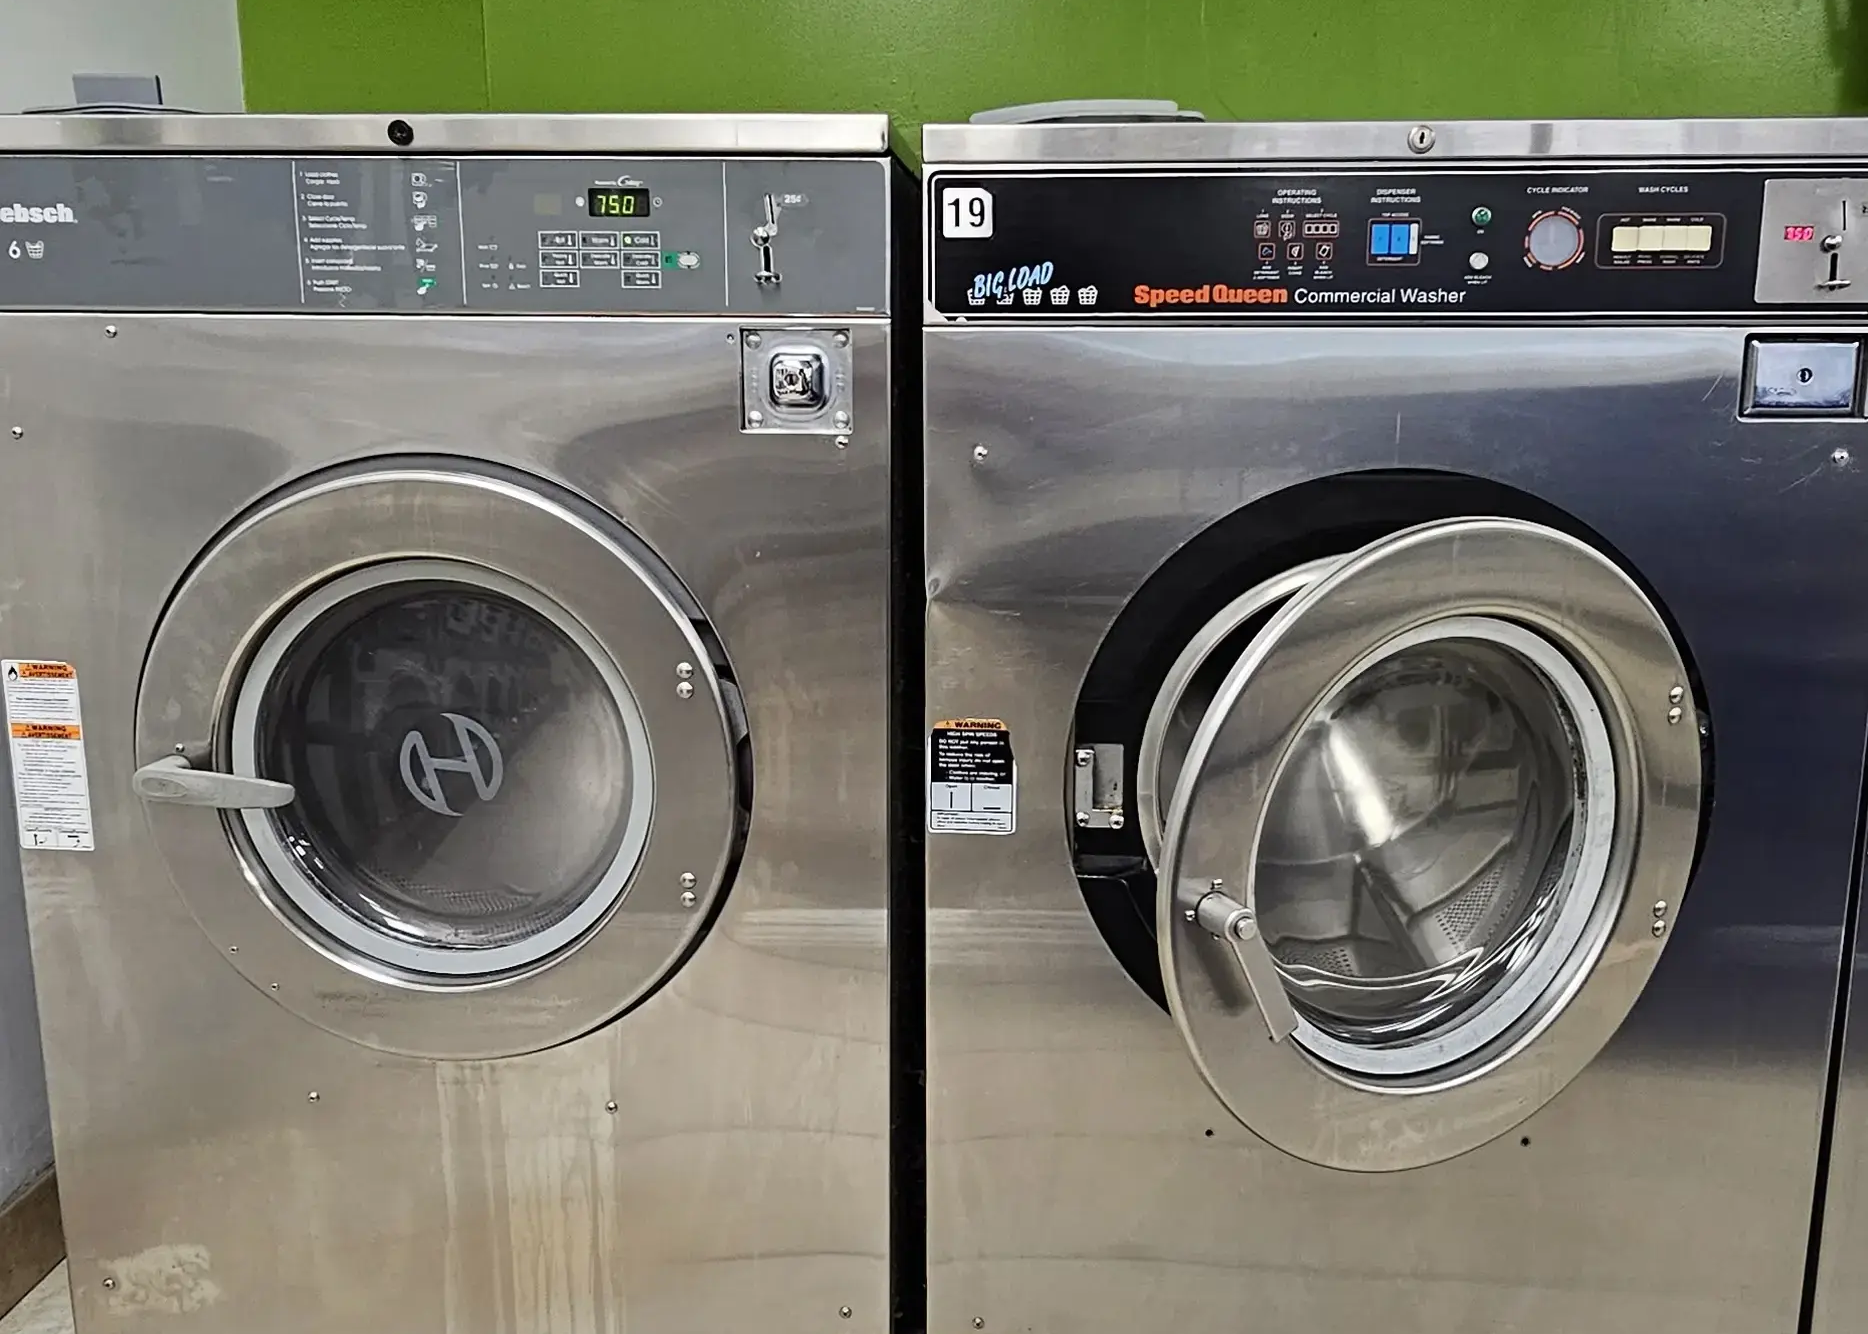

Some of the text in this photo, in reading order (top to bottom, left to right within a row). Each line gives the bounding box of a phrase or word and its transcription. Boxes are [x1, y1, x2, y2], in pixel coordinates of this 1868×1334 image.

[1277, 189, 1317, 197] OPERATING
[1526, 186, 1550, 194] CYCLE
[1638, 186, 1689, 194] WASH CYCLES
[1271, 197, 1322, 205] INSTRUCTIONS
[1370, 196, 1421, 204] INSTRUCTIONS
[947, 197, 985, 228] 19
[8, 240, 21, 259] 6
[973, 261, 1054, 299] BIG LOAD
[1134, 284, 1466, 307] Speed Queen Commercial Washer
[954, 721, 1001, 729] WARNING
